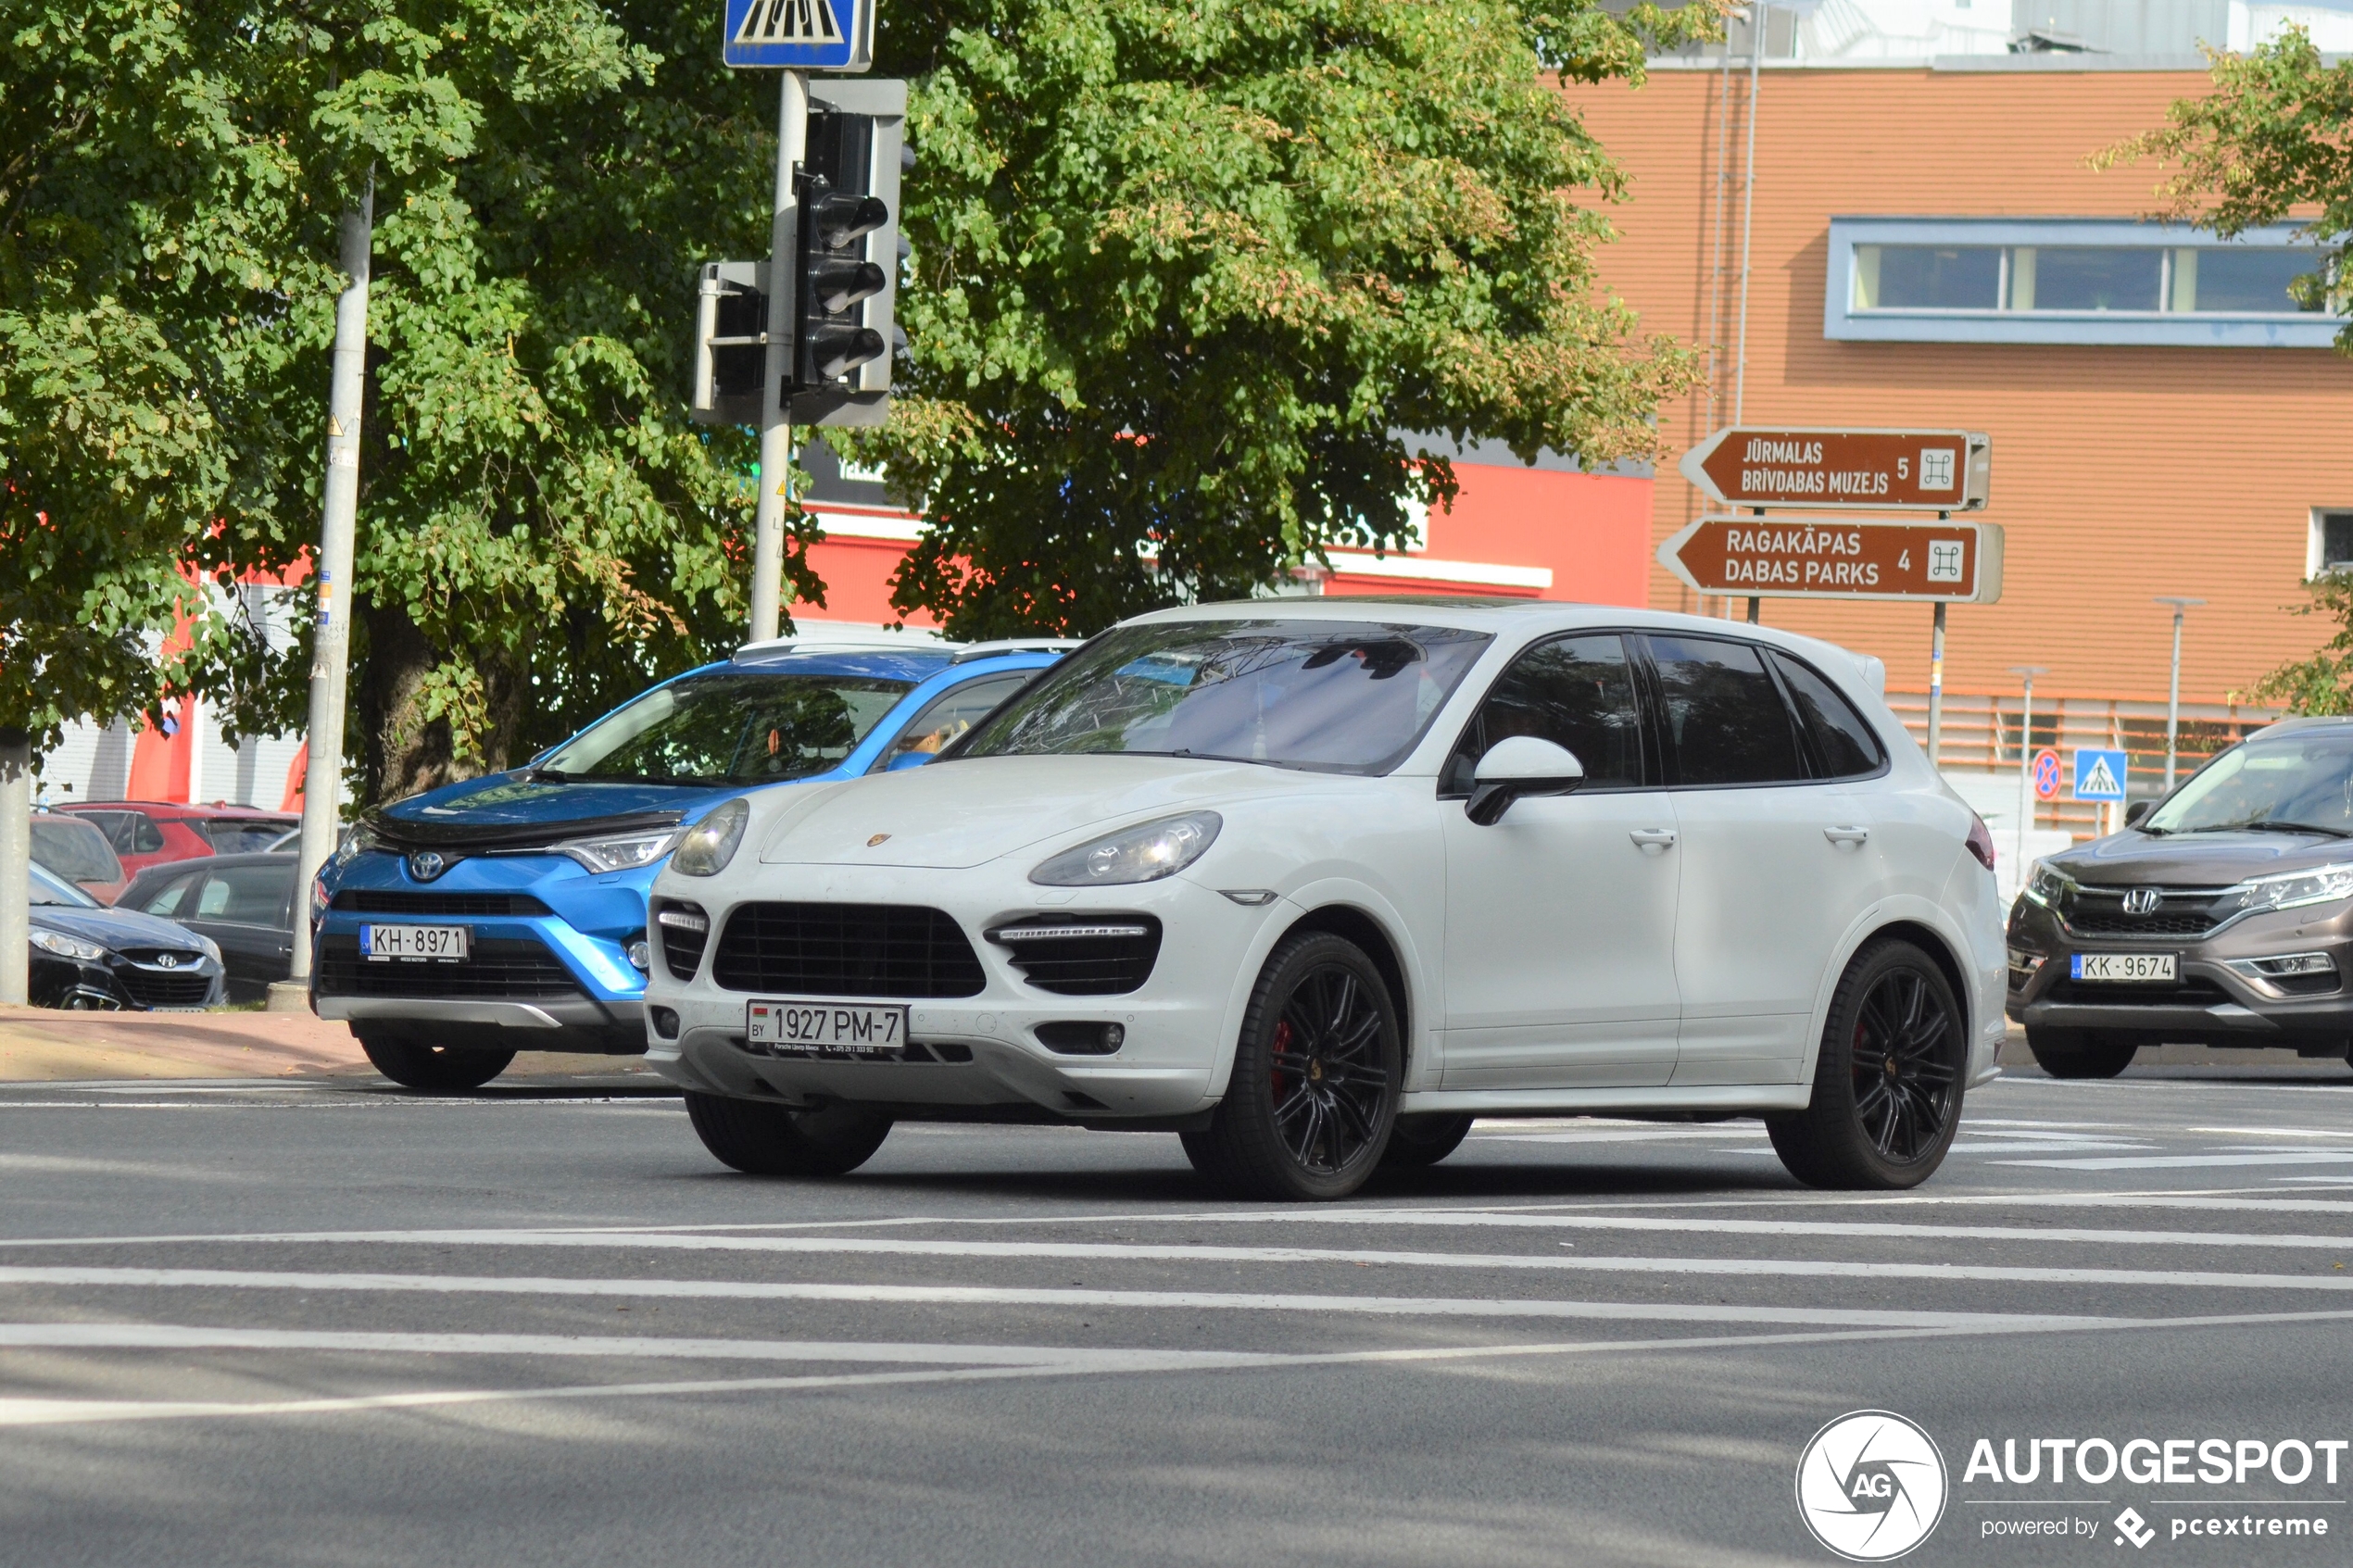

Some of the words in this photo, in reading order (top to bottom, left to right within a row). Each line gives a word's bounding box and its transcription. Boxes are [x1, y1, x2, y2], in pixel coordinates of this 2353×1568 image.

[1743, 438, 1823, 465] JŪRMALAS
[1741, 467, 1825, 494] BRĪVDABAS
[1828, 471, 1889, 495] MUZEJS
[1896, 458, 1909, 481] 5
[1726, 527, 1861, 556] RAGAKĀPAS
[1725, 558, 1798, 583] DABAS
[1805, 561, 1880, 585] PARKS
[1897, 548, 1911, 572] 4
[374, 928, 460, 954] KH-8971
[2084, 957, 2171, 977] KK-9674
[751, 1023, 765, 1037] BY
[774, 1008, 827, 1039] 1927
[835, 1010, 899, 1042] PM-7
